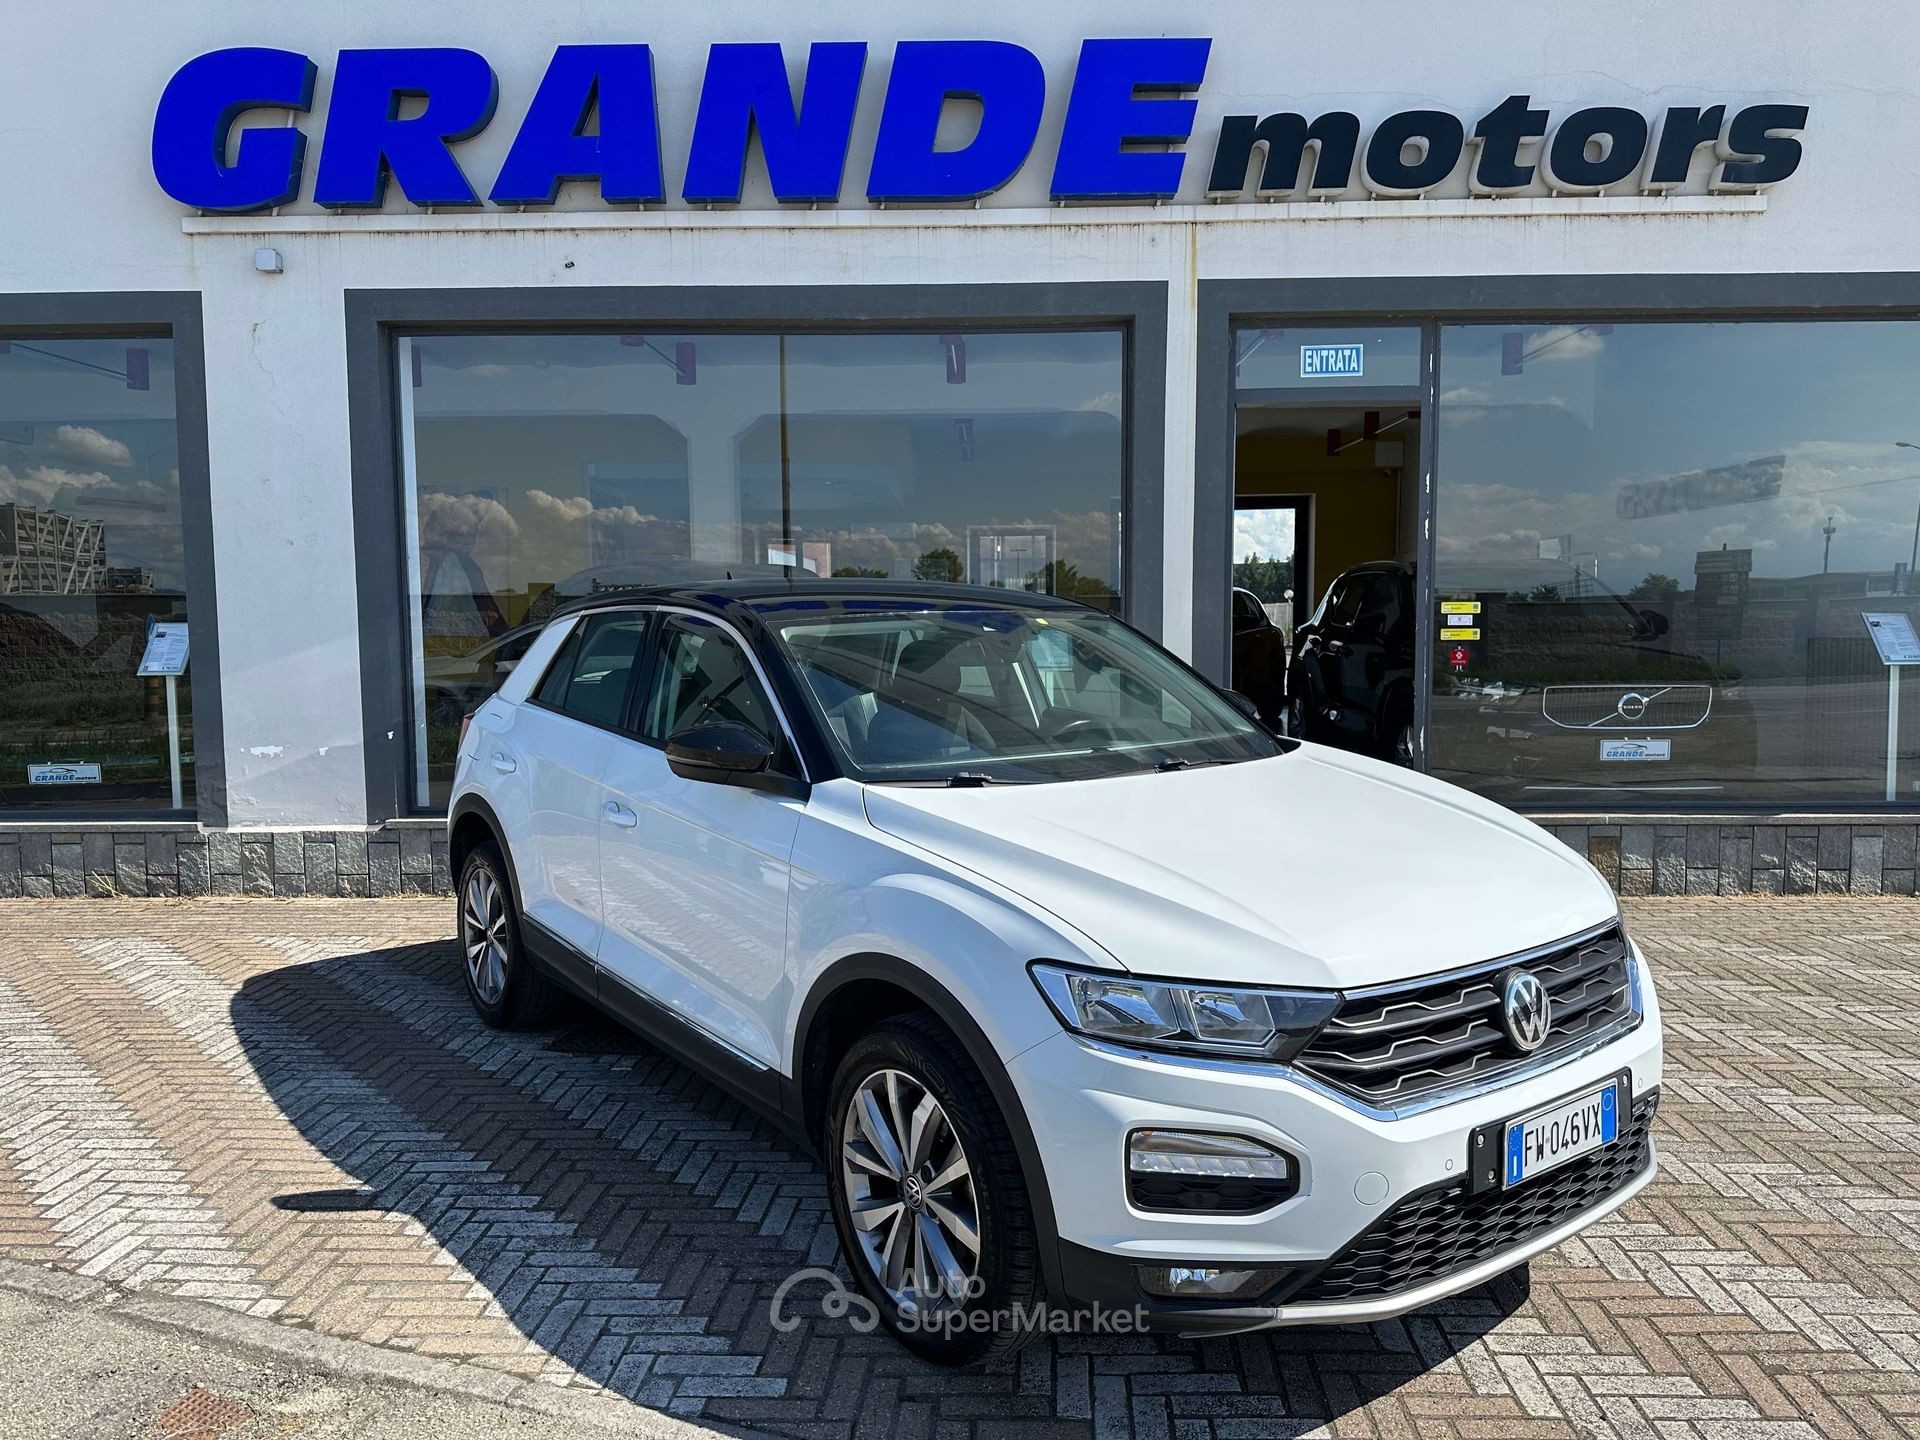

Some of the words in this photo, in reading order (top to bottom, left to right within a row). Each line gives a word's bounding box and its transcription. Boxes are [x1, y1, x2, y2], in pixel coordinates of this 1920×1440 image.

[151, 38, 1211, 211] GRANDE
[1206, 94, 1810, 196] motors
[1304, 348, 1359, 373] ENTRATA
[1606, 750, 1645, 758] GRANDE
[34, 773, 76, 782] GRANDE
[1524, 1124, 1545, 1168] FW
[1550, 1101, 1601, 1156] 046VX
